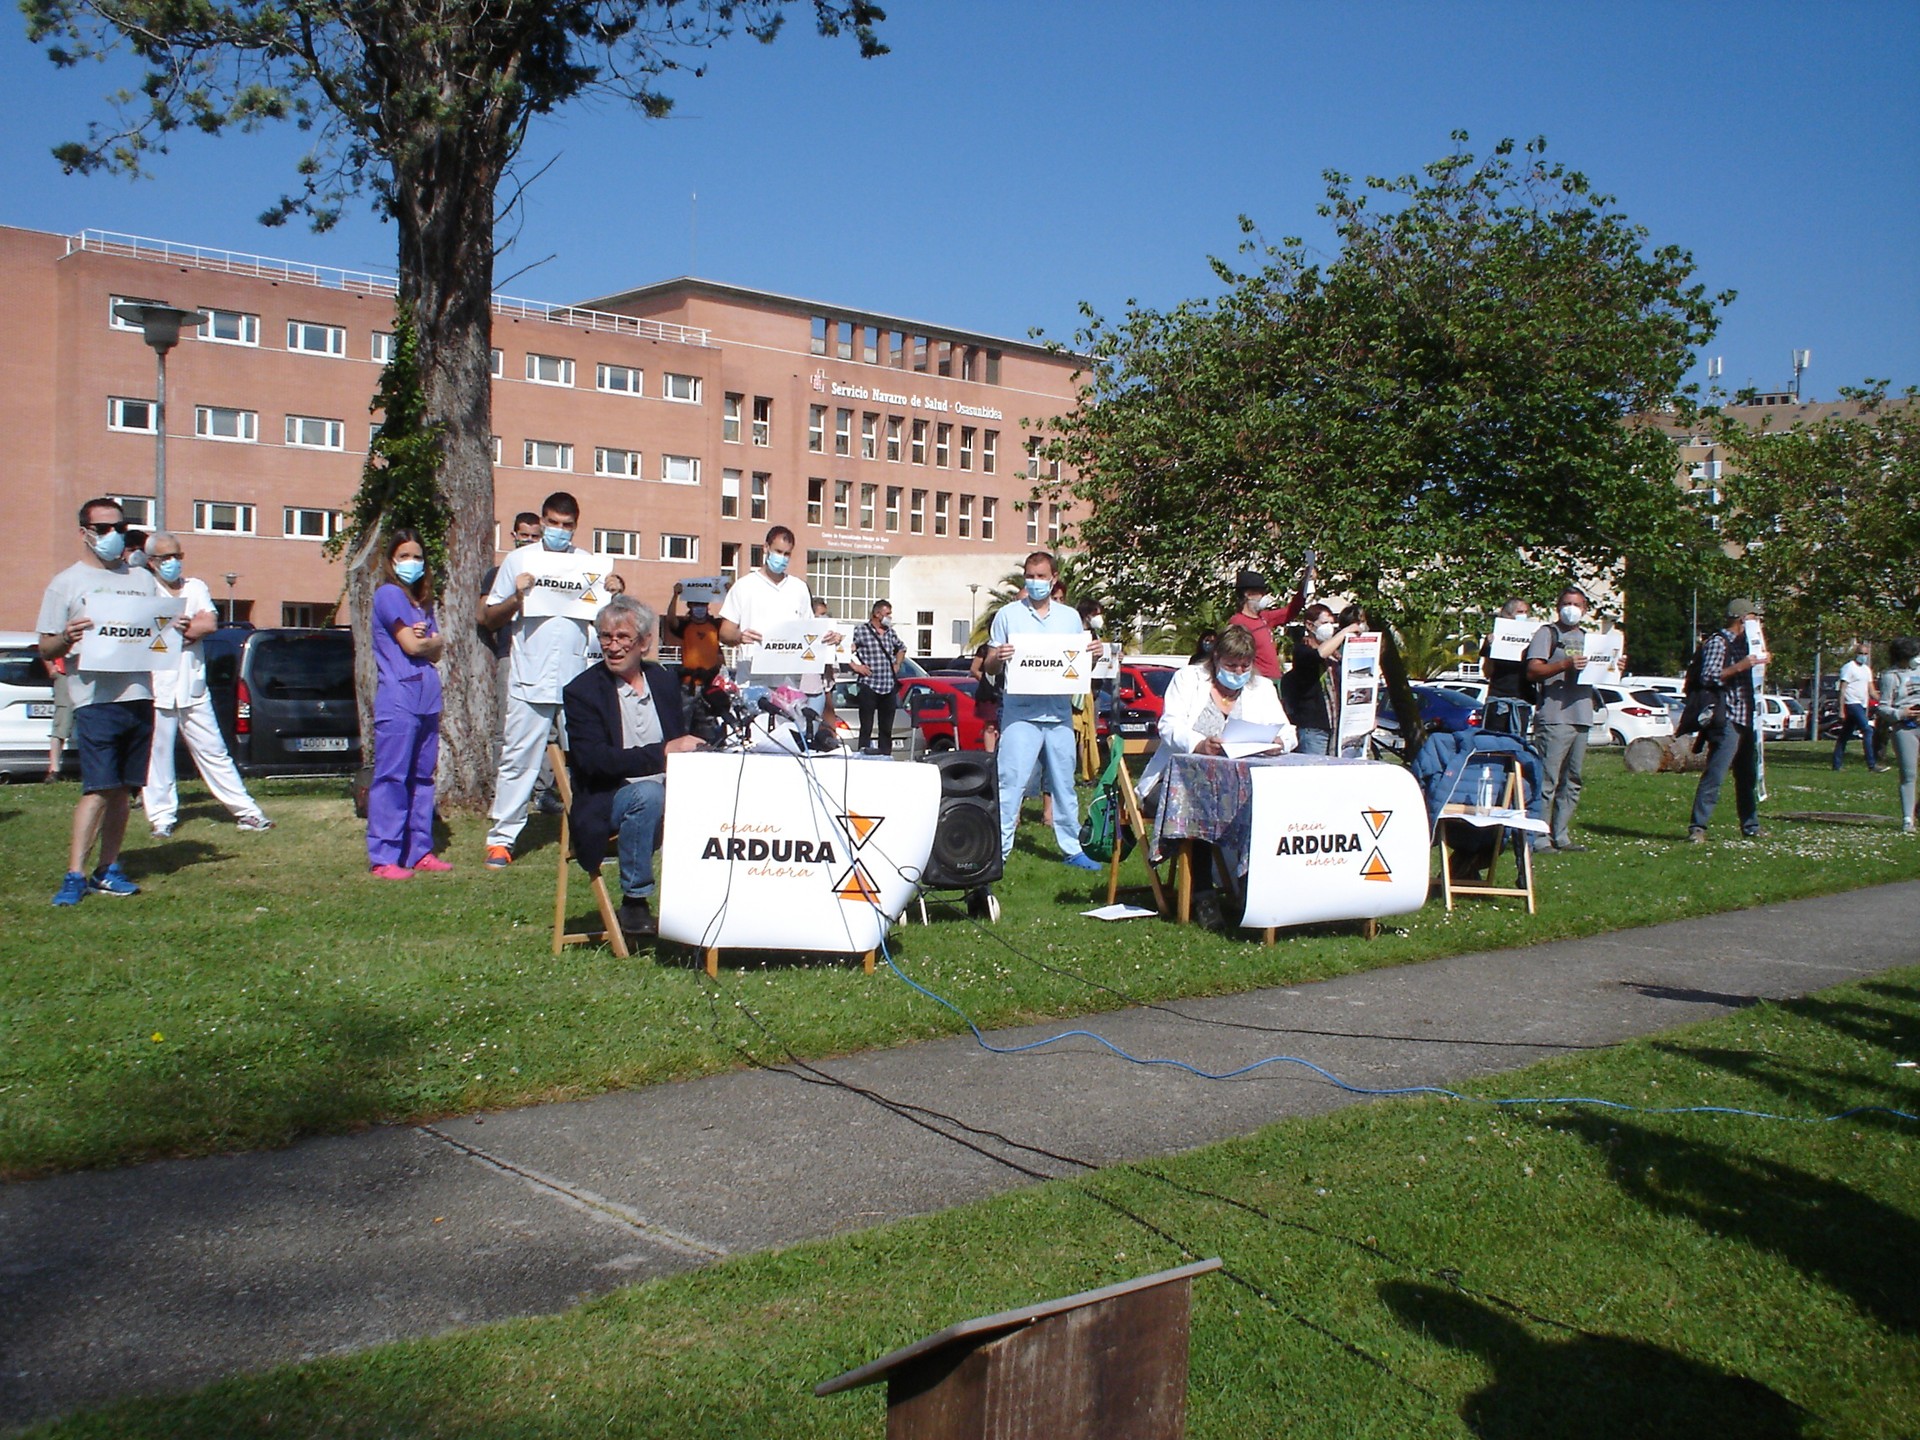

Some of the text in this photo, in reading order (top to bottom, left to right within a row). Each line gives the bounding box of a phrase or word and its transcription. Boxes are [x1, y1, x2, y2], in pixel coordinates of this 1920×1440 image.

[831, 381, 869, 401] Servicio
[872, 388, 907, 406] Navarro
[910, 394, 922, 407] de
[924, 397, 948, 412] Salud
[535, 578, 583, 591] ARDURA
[98, 626, 152, 638] ARDURA
[764, 642, 803, 650] ARDURA
[1020, 659, 1064, 668] ARDURA
[720, 822, 782, 833] orain
[1287, 820, 1326, 833] orain
[701, 837, 837, 864] ARDURA
[1276, 833, 1362, 856] ARDURA
[1305, 850, 1349, 867] ahora
[747, 858, 815, 878] ahora
